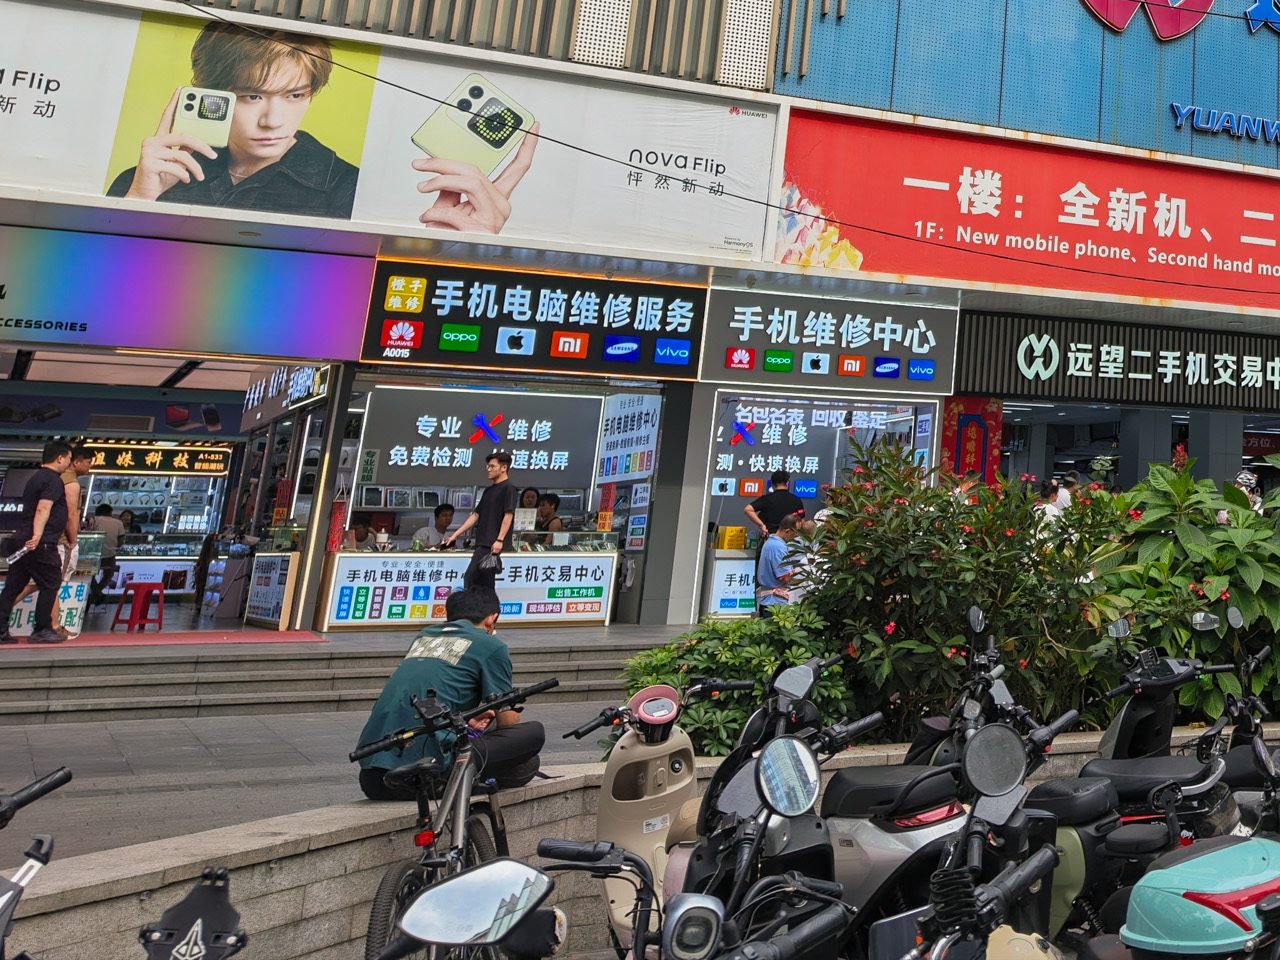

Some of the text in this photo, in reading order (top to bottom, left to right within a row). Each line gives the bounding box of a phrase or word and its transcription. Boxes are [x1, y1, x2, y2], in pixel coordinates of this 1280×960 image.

[12, 70, 61, 95] Flip
[741, 110, 768, 119] HUAWEI
[629, 148, 726, 177] nova Flip
[627, 170, 725, 197] 怦然新动
[723, 239, 754, 249] HarmonyOS
[956, 226, 999, 246] New
[1005, 234, 1069, 254] mobile
[1147, 247, 1208, 269] Second
[1213, 253, 1253, 274] hand
[391, 279, 424, 292] 橙子
[388, 295, 420, 310] 维修
[431, 279, 695, 334] 手机电脑维修服务
[729, 305, 937, 354] 手机维修中心
[387, 339, 414, 347] HUAWEI
[383, 347, 410, 359] A0015
[656, 347, 689, 358] vivo
[910, 367, 934, 376] vivo
[734, 403, 805, 426] 名包名表
[811, 409, 846, 427] 回收
[416, 415, 553, 442] 专业 维修
[762, 424, 808, 446] 维修
[388, 445, 473, 468] 免费检测
[795, 485, 817, 494] vivo
[346, 569, 465, 583] 手机电脑维修中
[555, 588, 596, 598] 出售工作机
[528, 603, 561, 613] 现场评估
